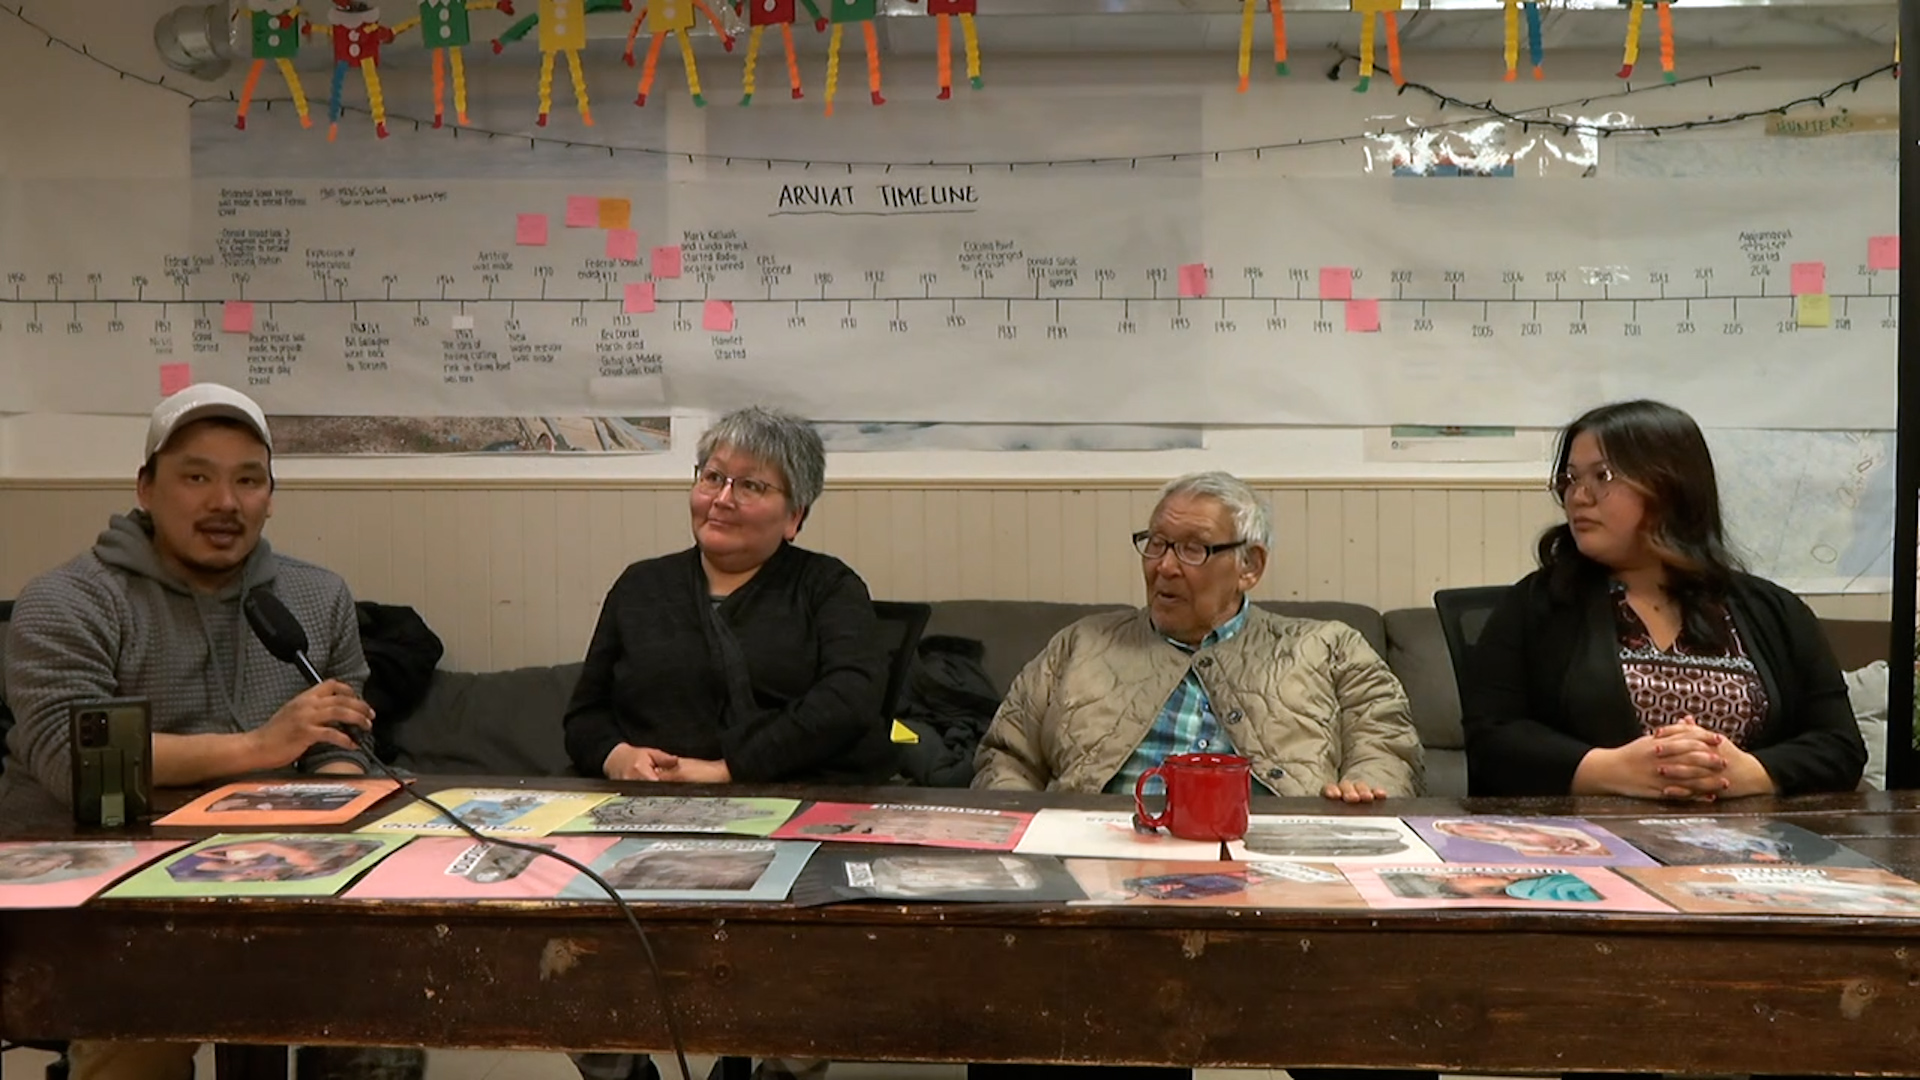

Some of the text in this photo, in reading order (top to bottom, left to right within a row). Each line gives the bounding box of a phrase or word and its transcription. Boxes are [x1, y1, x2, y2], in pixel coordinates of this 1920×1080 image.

[779, 184, 979, 208] ARVIAT TIMELINE
[533, 265, 555, 278] 1970
[1094, 268, 1116, 282] 1990
[1390, 270, 1413, 284] 2002
[672, 319, 693, 332] 1975
[1117, 320, 1137, 334] 1991
[1170, 317, 1191, 331] 1993
[1266, 317, 1288, 331] 1997
[1313, 319, 1334, 333] 1999
[1471, 324, 1495, 338] 2005
[1520, 323, 1543, 337] 2007
[710, 334, 744, 347] Hamlet
[714, 348, 747, 361] Started
